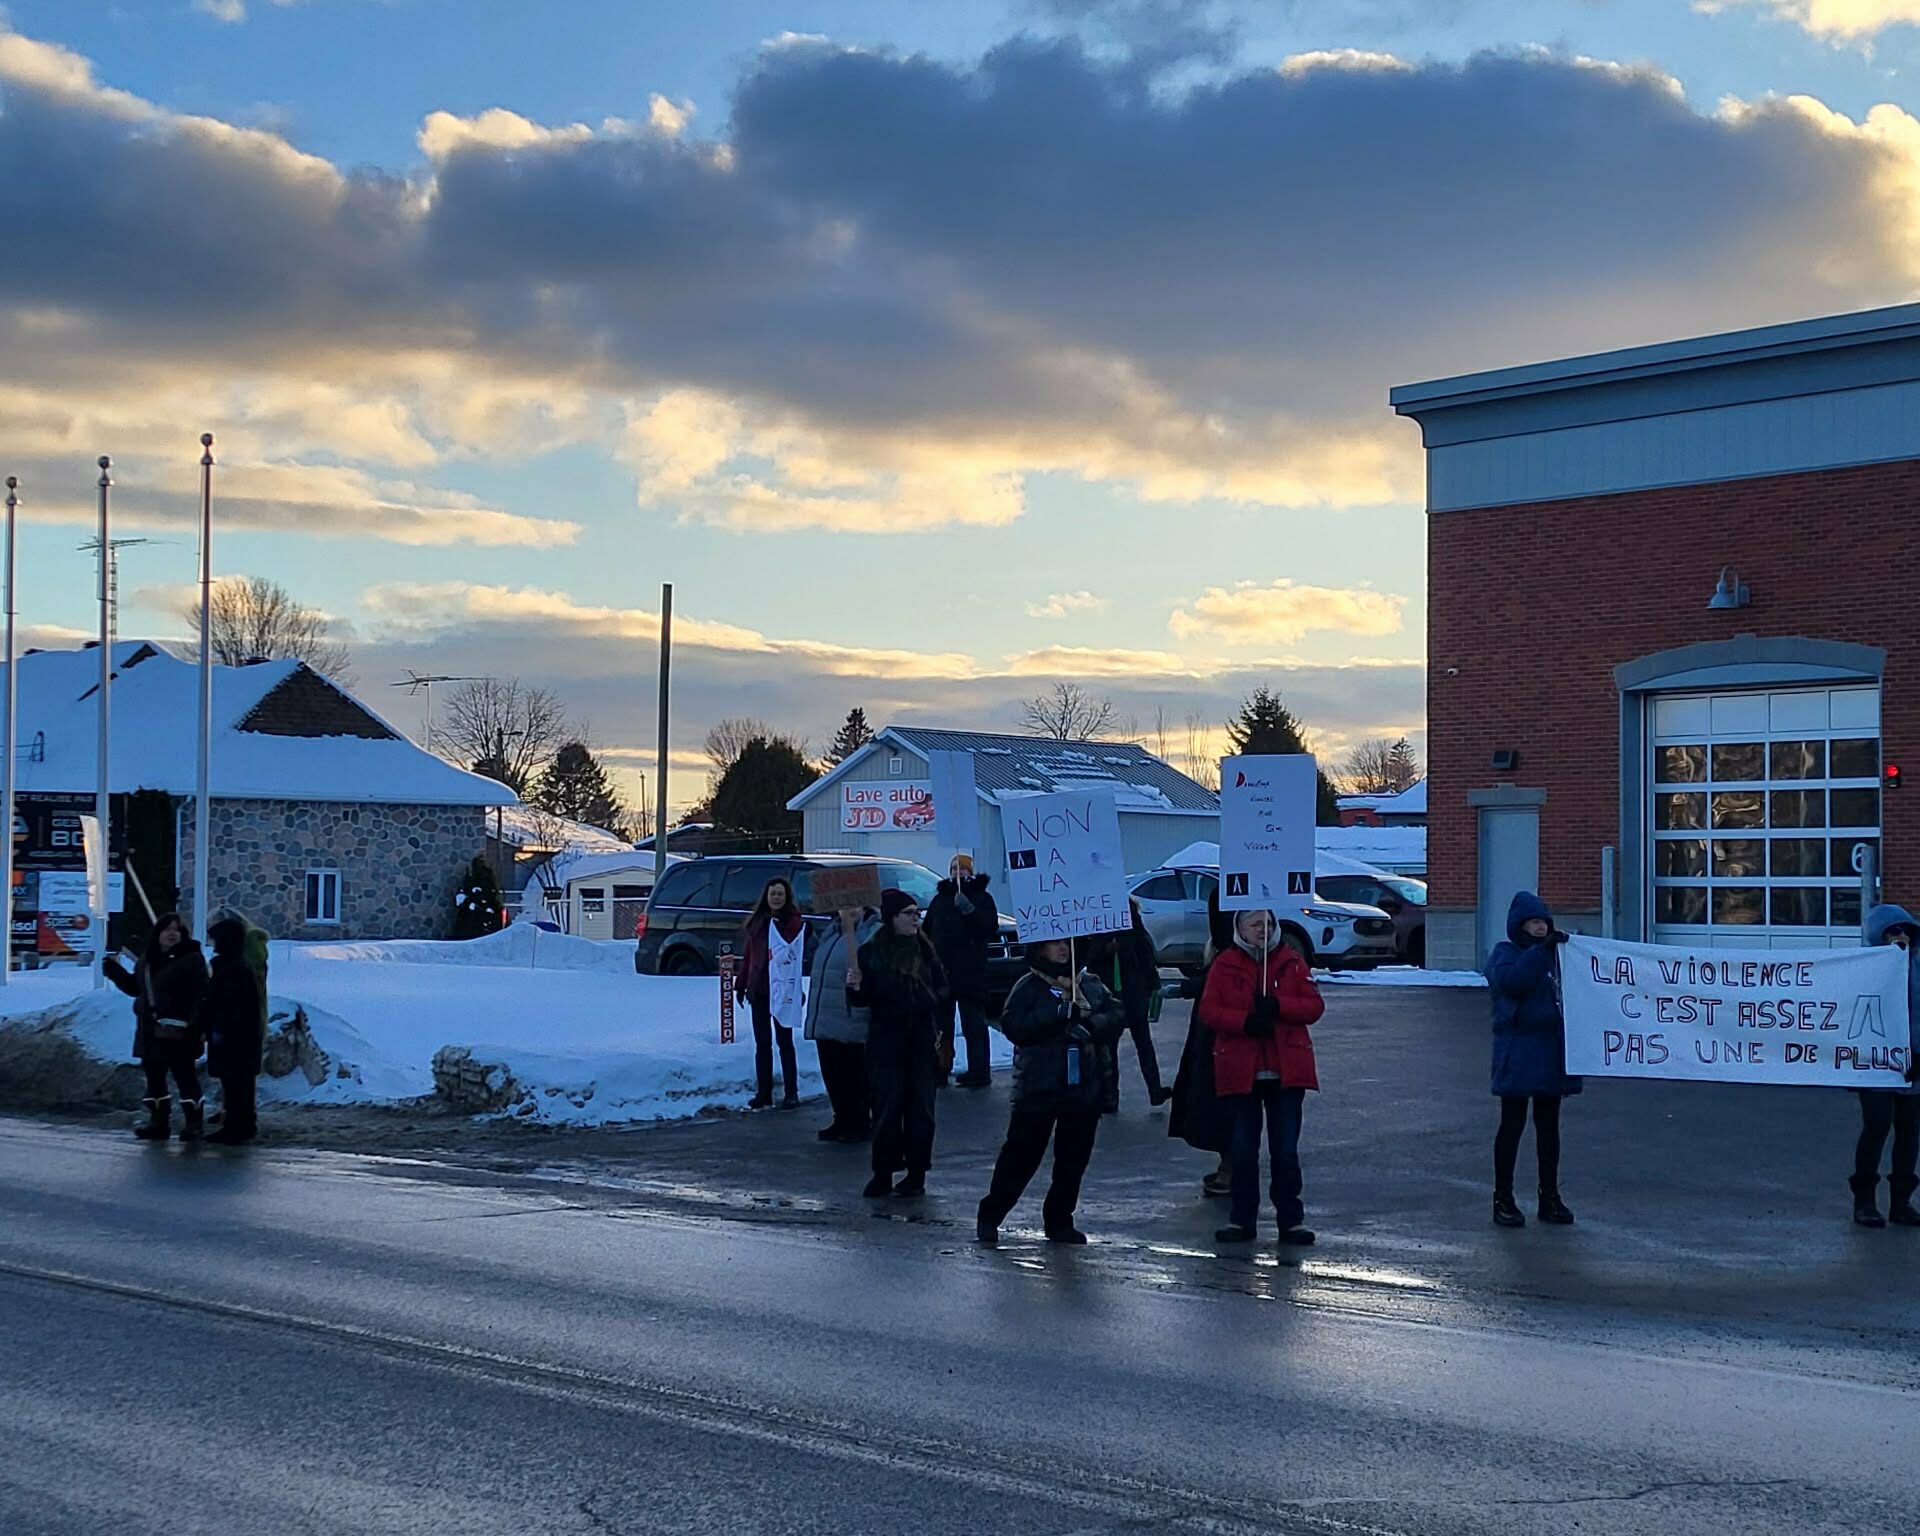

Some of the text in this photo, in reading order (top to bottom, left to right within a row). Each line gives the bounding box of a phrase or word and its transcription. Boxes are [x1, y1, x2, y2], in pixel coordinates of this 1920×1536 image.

[845, 785, 925, 803] Lave auto
[844, 806, 887, 829] JD
[1018, 800, 1093, 845] NON
[1039, 871, 1070, 893] LA
[1591, 955, 1636, 986] LA
[1620, 992, 1840, 1031] C'EST ASSEZ
[1603, 1030, 1670, 1067] PAS
[1694, 1039, 1765, 1065] UNE
[1784, 1042, 1819, 1065] DE
